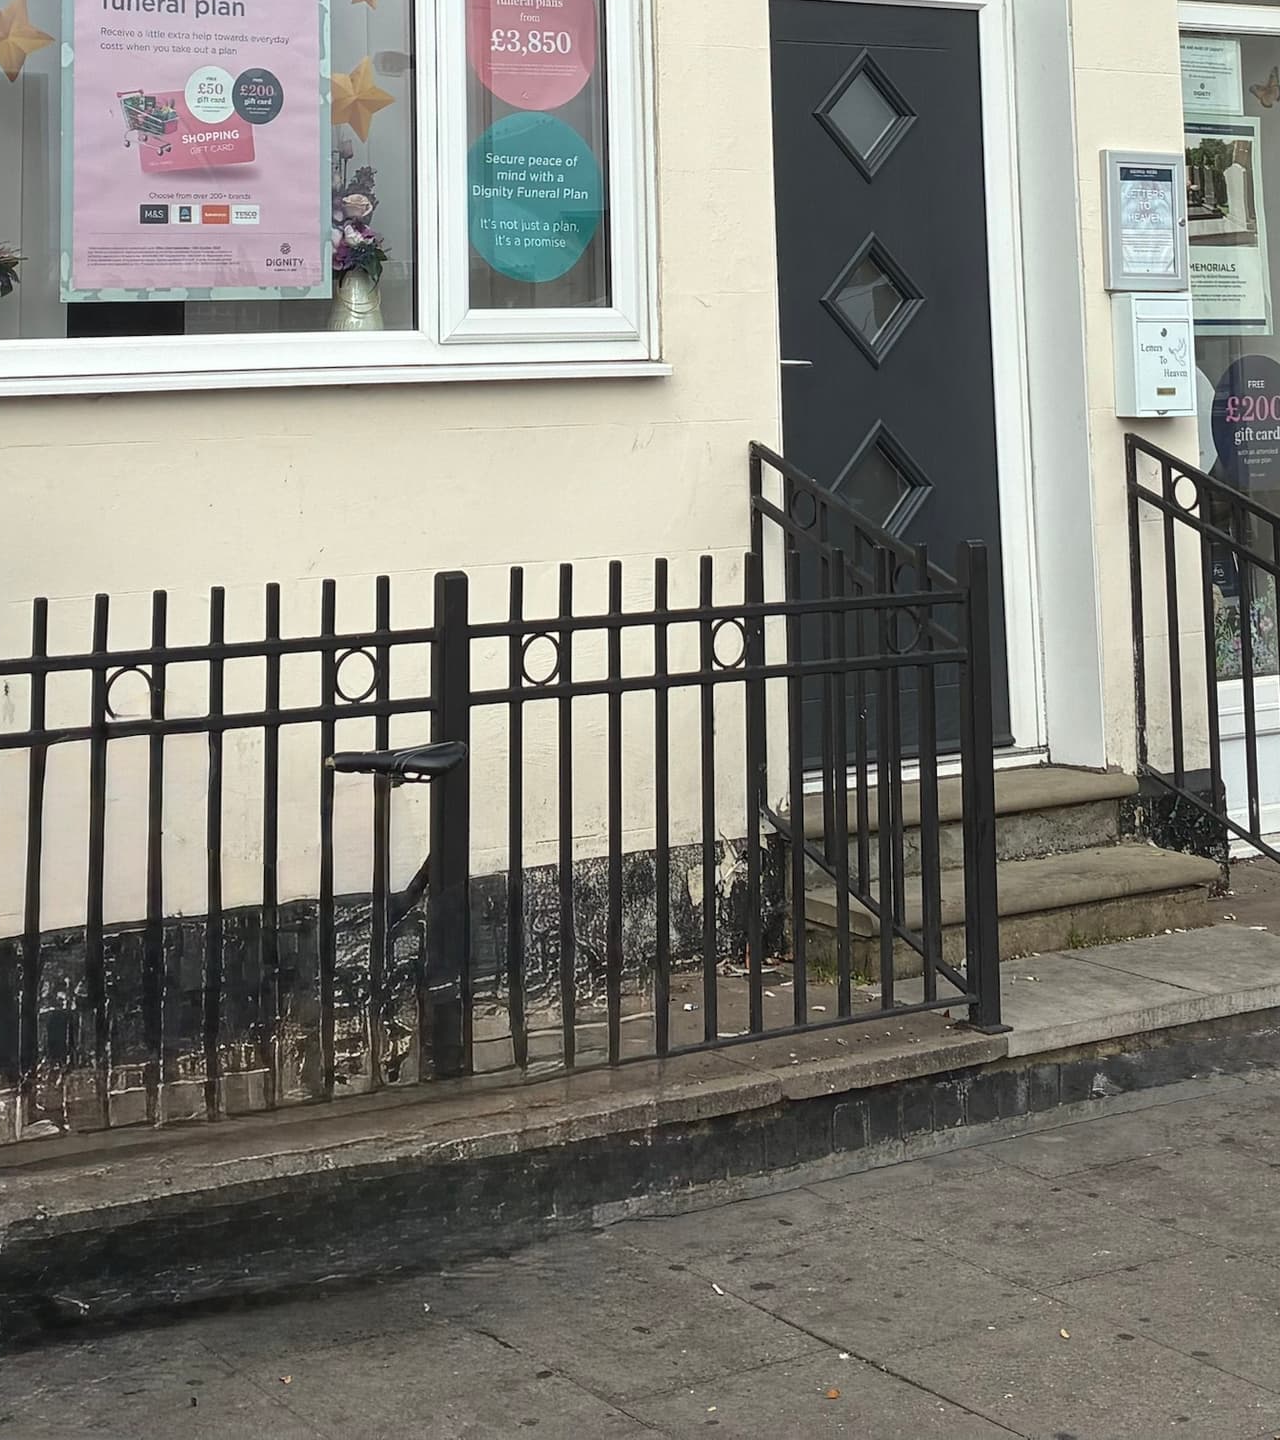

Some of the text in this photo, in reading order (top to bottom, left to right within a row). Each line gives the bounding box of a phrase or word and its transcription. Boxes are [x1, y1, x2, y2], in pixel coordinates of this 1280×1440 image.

[519, 12, 540, 23] from
[100, 27, 289, 45] Receive little extra help towards everyday
[490, 29, 571, 57] £3,850
[100, 41, 237, 56] costs when take out plan
[197, 82, 224, 96] £50
[239, 84, 275, 97] £200
[181, 129, 239, 144] SHOPPING
[190, 143, 234, 155] GIFT CARD
[485, 152, 578, 168] Secure peace of
[496, 168, 555, 183] mind with
[148, 191, 251, 201] Choose from brands
[472, 185, 589, 200] Dignity Funeral Plan
[144, 210, 164, 219] M&S
[480, 218, 540, 234] It's not just
[524, 236, 566, 251] promise
[266, 258, 304, 267] DIGNITY
[1247, 380, 1265, 389] FREE
[1234, 425, 1280, 446] gift card
